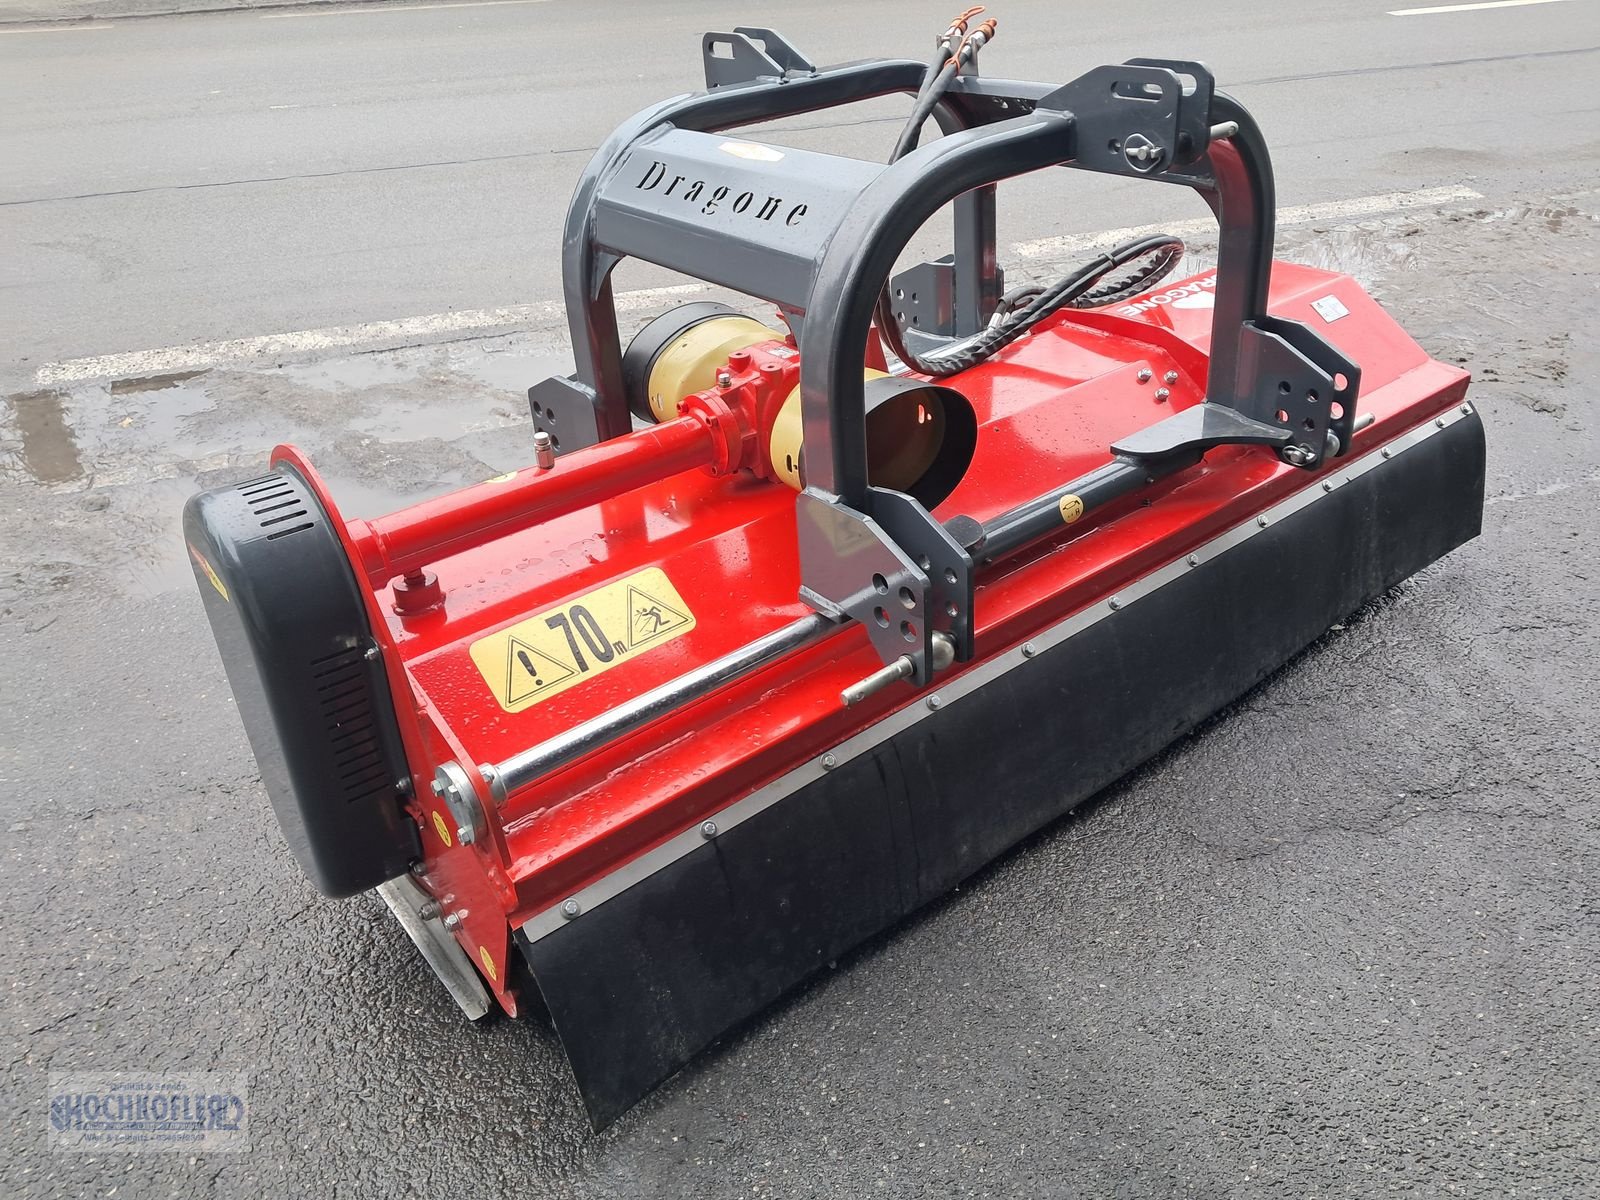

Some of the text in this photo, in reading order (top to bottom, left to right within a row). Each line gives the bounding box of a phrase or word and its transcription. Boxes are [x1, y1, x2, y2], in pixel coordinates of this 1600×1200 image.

[635, 160, 808, 226] Dragone
[1116, 274, 1217, 317] RAGONE
[545, 604, 615, 673] 70
